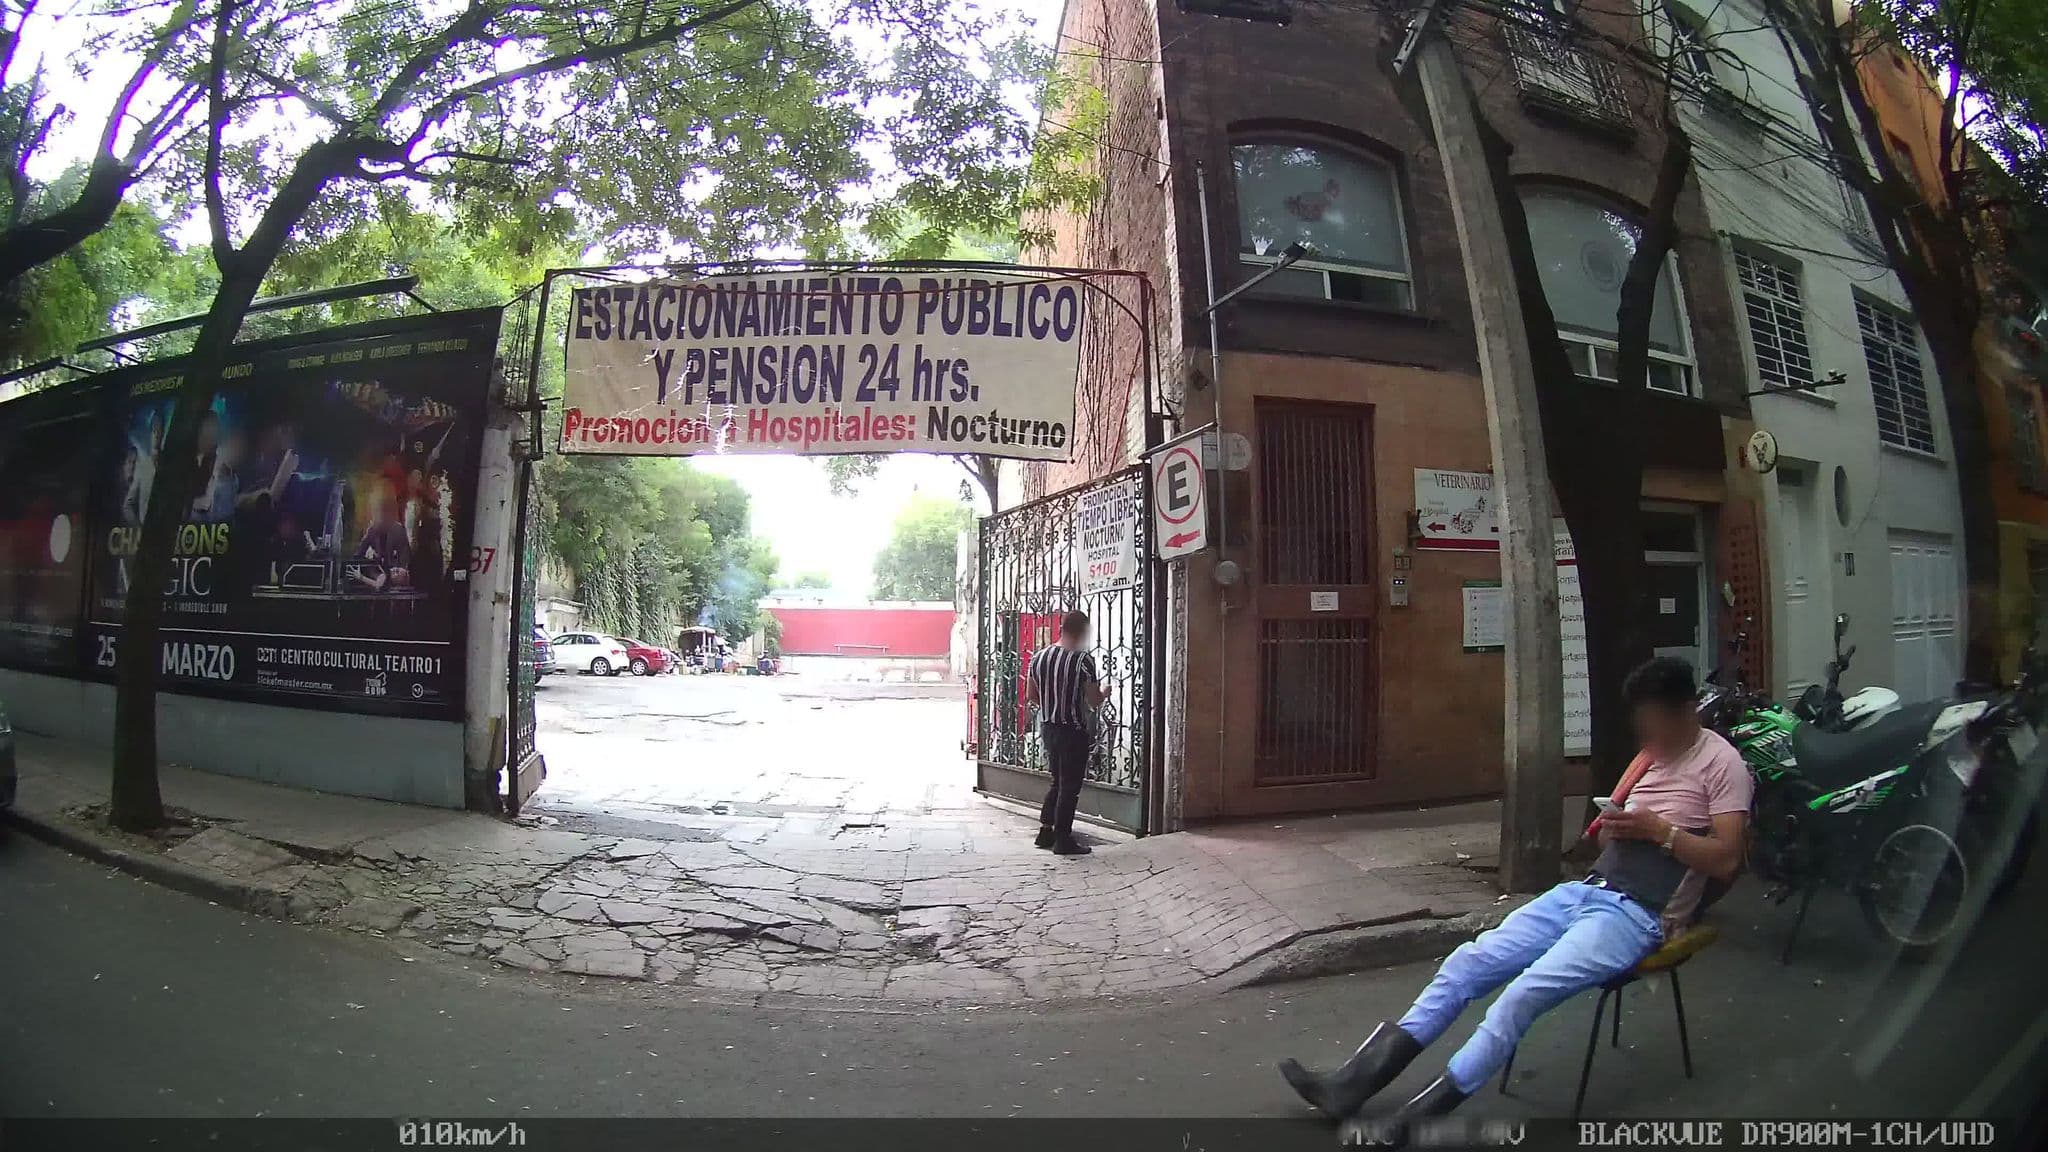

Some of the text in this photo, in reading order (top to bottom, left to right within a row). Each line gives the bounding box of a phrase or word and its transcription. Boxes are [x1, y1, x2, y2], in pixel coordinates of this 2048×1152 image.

[575, 277, 1077, 342] ESTACIONAMIENTO PUBLICO
[650, 343, 979, 405] Y PENSION 24 hrs.
[564, 407, 709, 445] Promocion
[747, 407, 916, 449] Hospitales:
[927, 406, 1066, 448] Nocturno
[1083, 485, 1128, 506] PROMOCION
[1167, 461, 1190, 511] E
[1083, 523, 1125, 549] NOCTURNO
[1088, 546, 1120, 561] HOSPITAL
[97, 634, 117, 667] 25
[162, 642, 236, 681] MARZO
[281, 649, 321, 667] CENTRO
[323, 652, 382, 672] CULTURAL
[384, 655, 433, 675] TEATRO
[434, 657, 442, 676] 1
